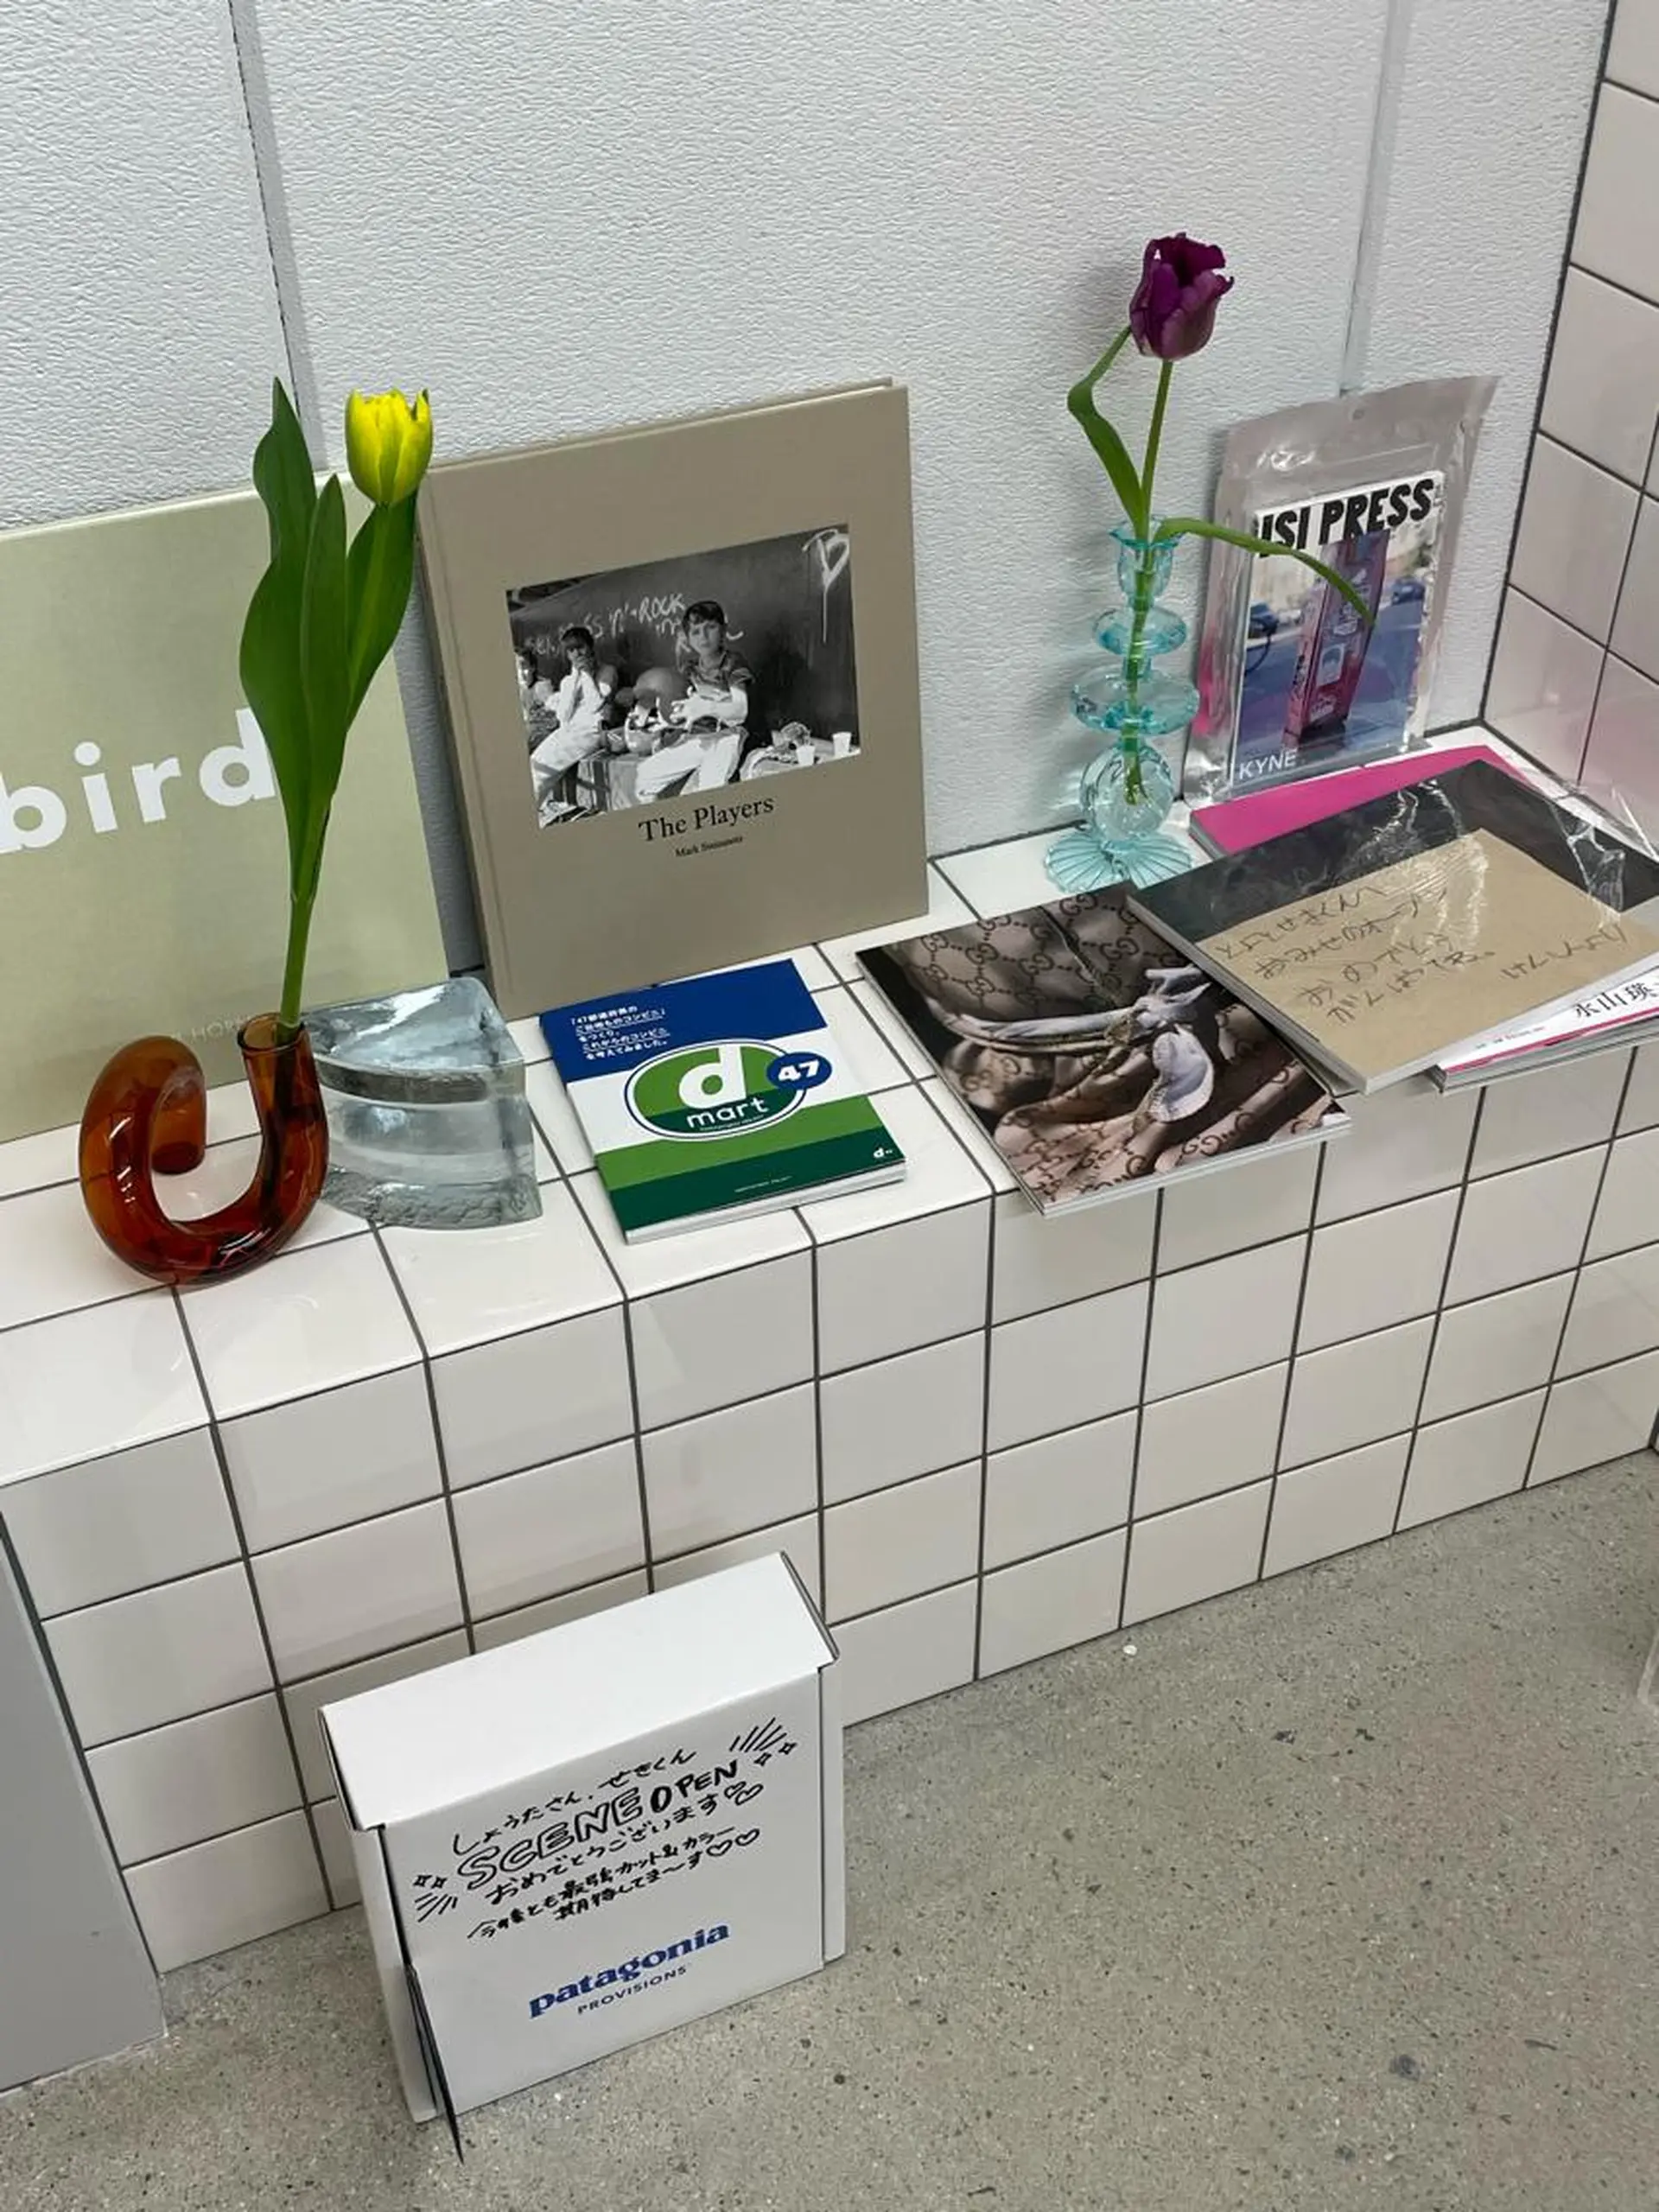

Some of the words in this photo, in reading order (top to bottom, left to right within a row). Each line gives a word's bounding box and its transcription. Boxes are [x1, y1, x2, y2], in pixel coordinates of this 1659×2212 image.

[1319, 479, 1434, 545] PRESS
[0, 707, 276, 855] bird
[1239, 747, 1298, 780] KYNE
[639, 817, 687, 842] The
[693, 798, 775, 830] Players
[679, 1043, 747, 1109] d
[778, 1059, 821, 1082] 47
[686, 1096, 769, 1128] mart
[457, 1786, 644, 1891] SCENE
[650, 1759, 739, 1814] OPEN
[529, 1923, 730, 2019] patagonia
[576, 1966, 688, 2016] PROVISIONS
